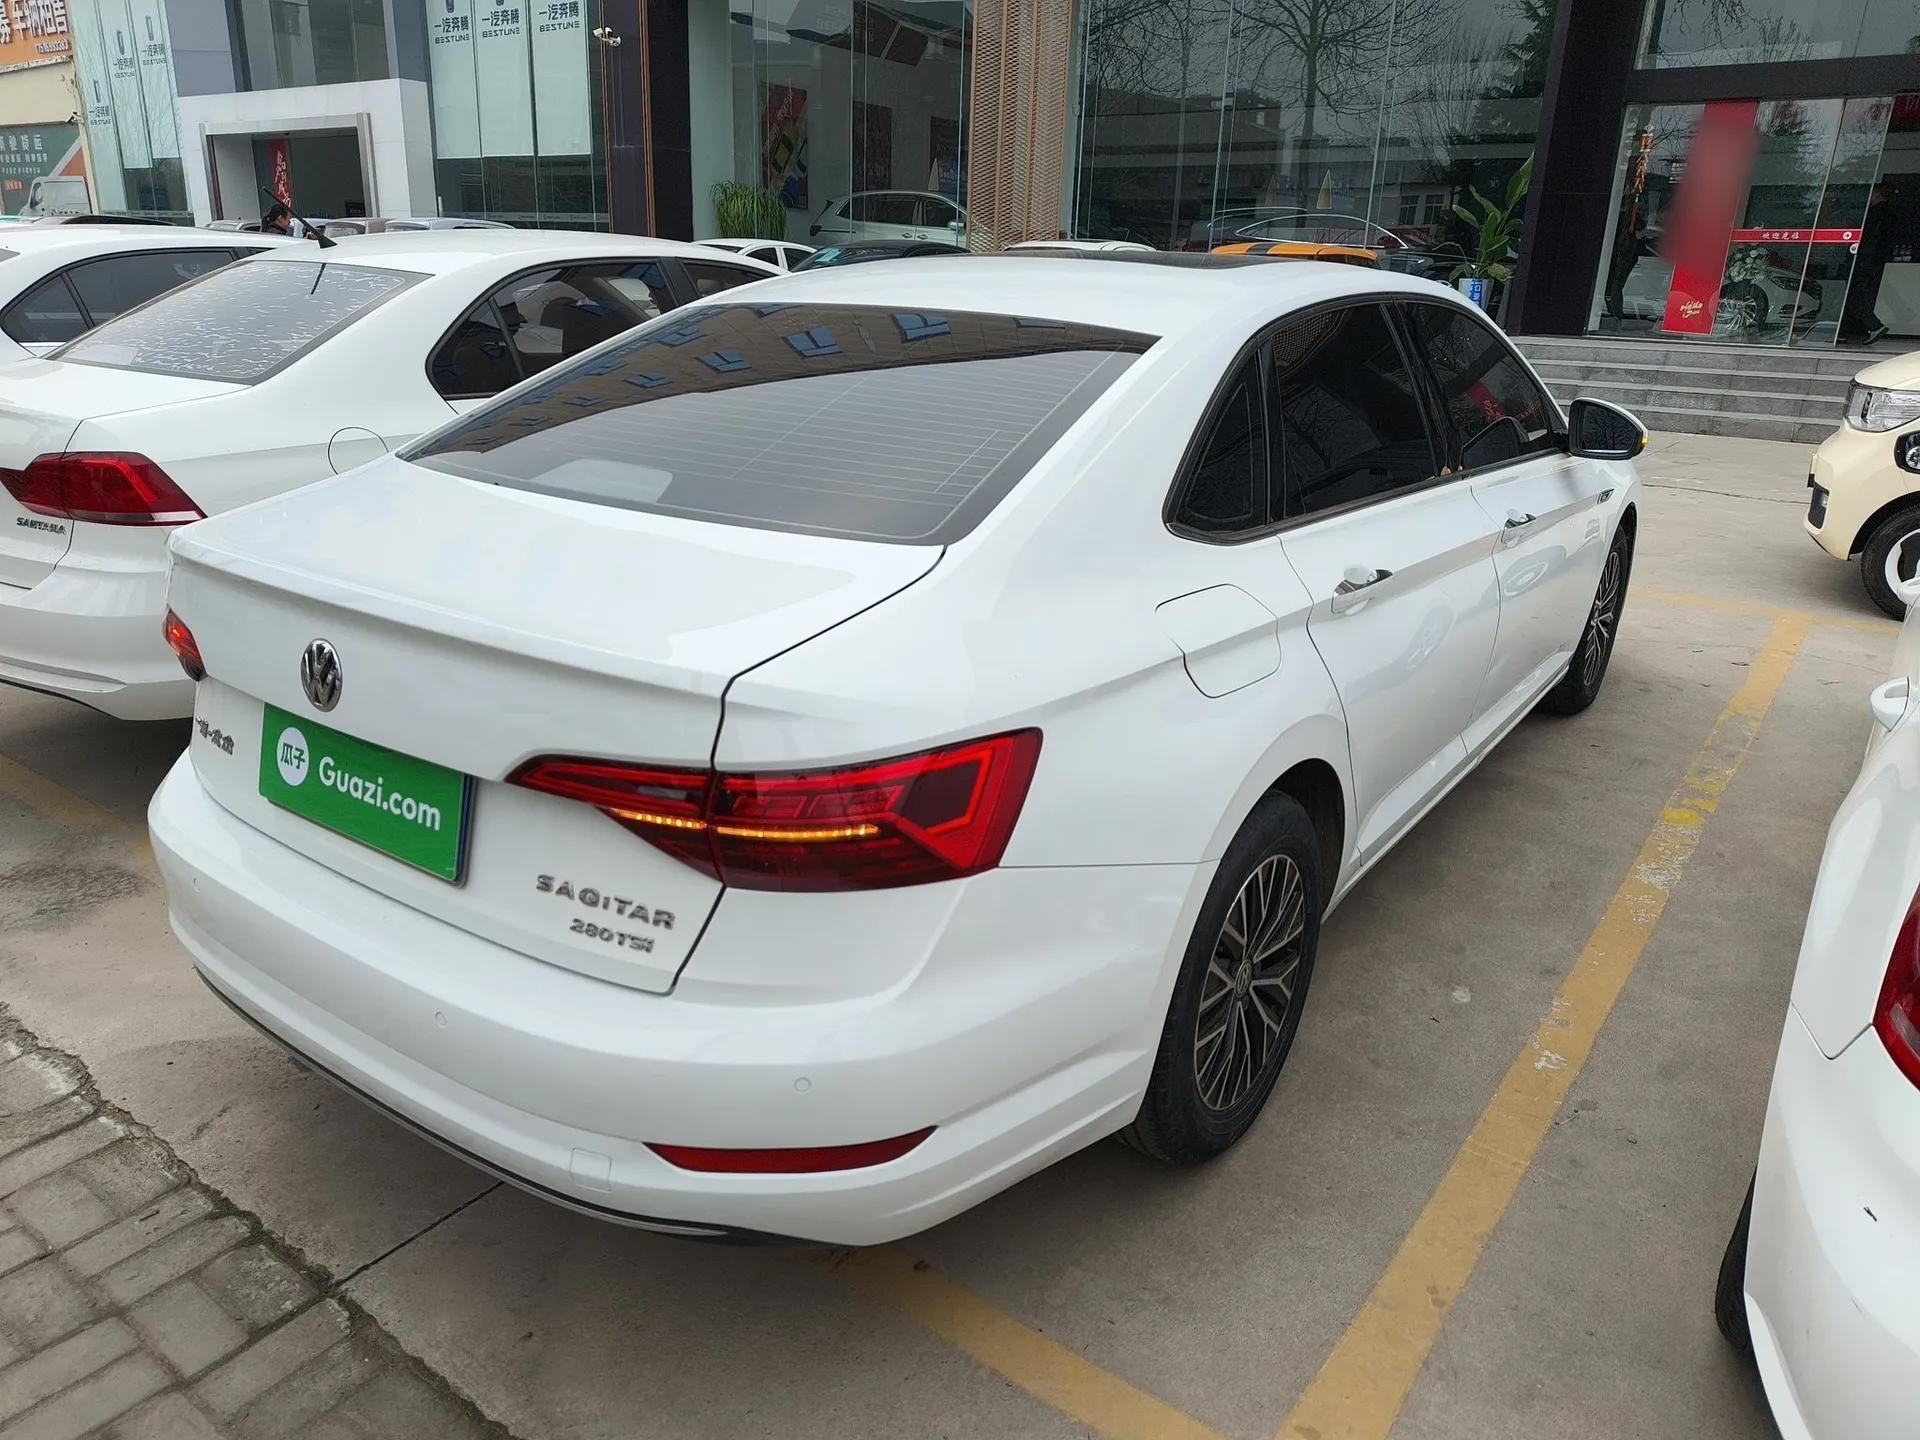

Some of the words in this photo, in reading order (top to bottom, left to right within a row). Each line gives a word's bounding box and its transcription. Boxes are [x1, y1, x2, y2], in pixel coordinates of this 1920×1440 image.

[481, 8, 520, 27] 一汽奔腾
[539, 1, 580, 20] 一汽奔腾
[434, 15, 469, 33] 一汽奔腾
[482, 27, 520, 38] BESTUNE
[539, 21, 580, 33] BESTUNE
[434, 34, 470, 45] BESTUNE
[1762, 231, 1800, 240] 欢迎光临
[280, 742, 306, 770] 瓜子
[319, 755, 442, 832] Guazi.com
[535, 873, 677, 931] SAGITAR
